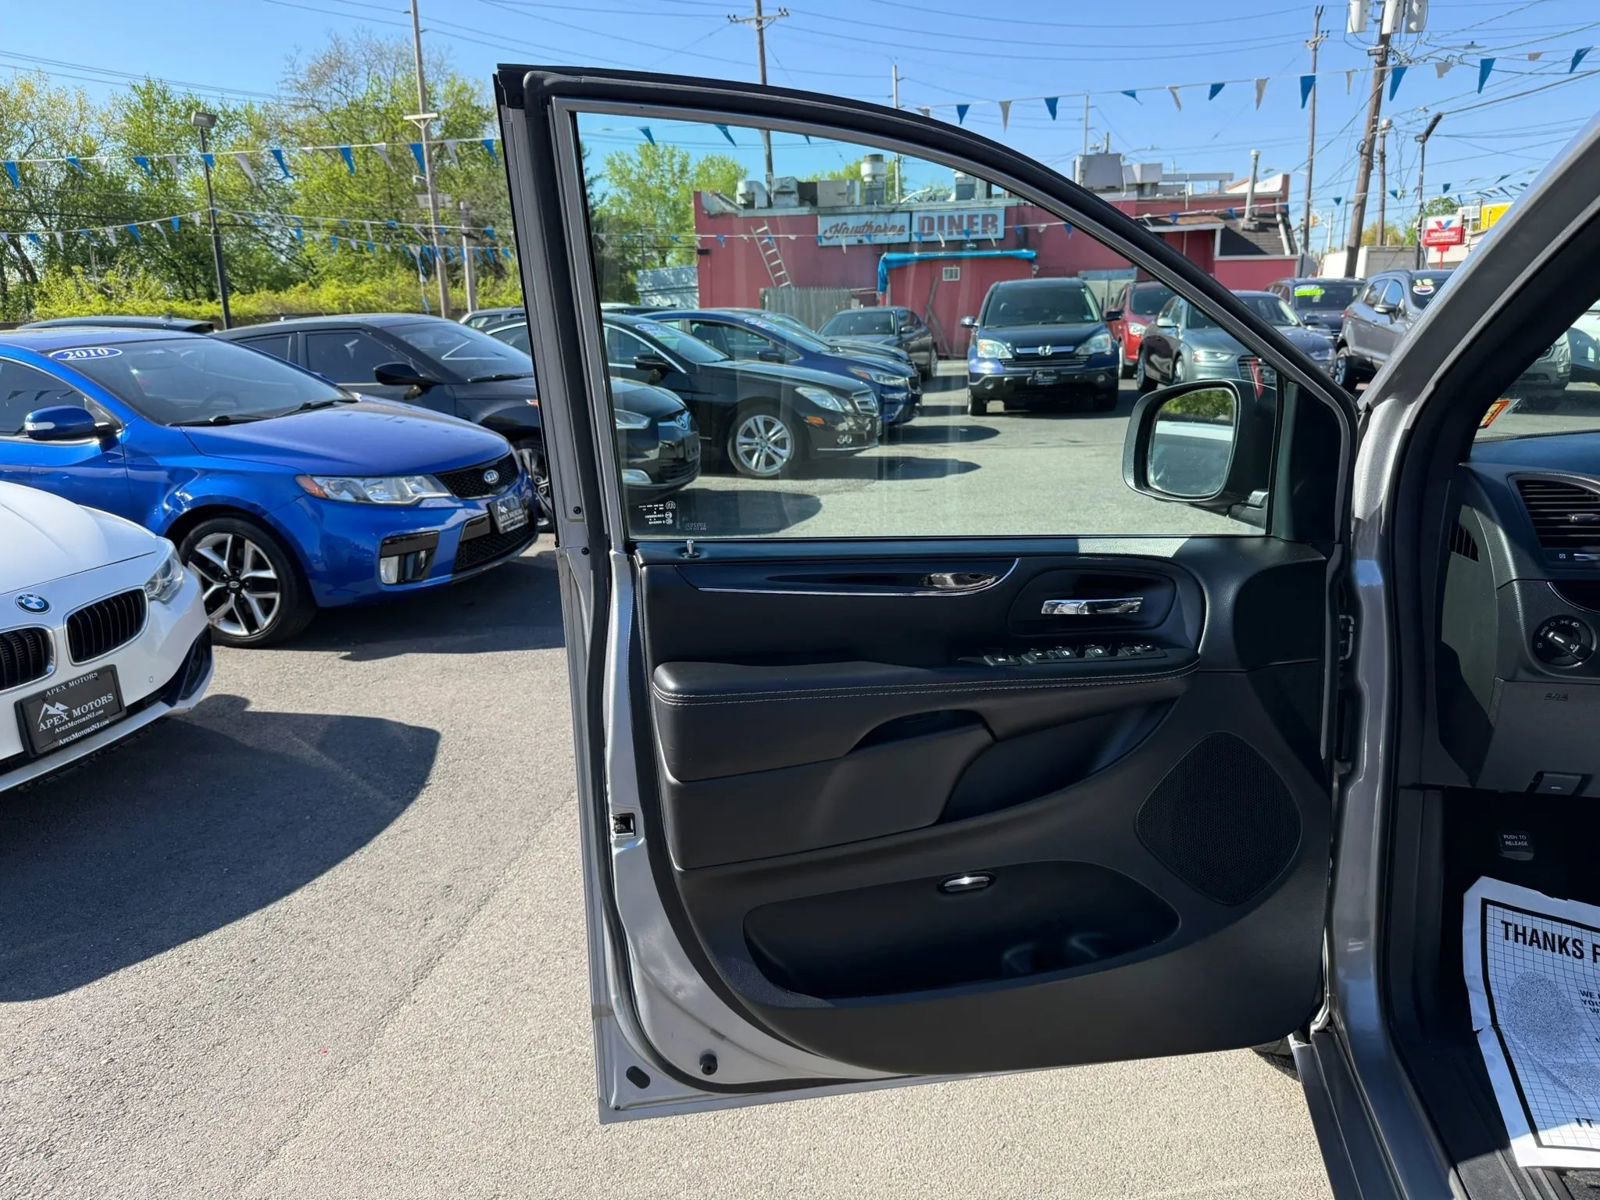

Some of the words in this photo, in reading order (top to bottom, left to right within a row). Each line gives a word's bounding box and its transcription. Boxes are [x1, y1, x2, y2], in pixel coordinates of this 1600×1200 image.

[917, 213, 998, 237] DINER
[63, 348, 109, 360] 2010
[45, 684, 67, 697] APEX
[68, 672, 98, 688] MOTORS
[38, 712, 70, 732] APEX
[71, 693, 114, 718] MOTORS
[1500, 920, 1585, 960] THANKS
[1580, 989, 1596, 999] WE
[1575, 1117, 1594, 1128] IT
